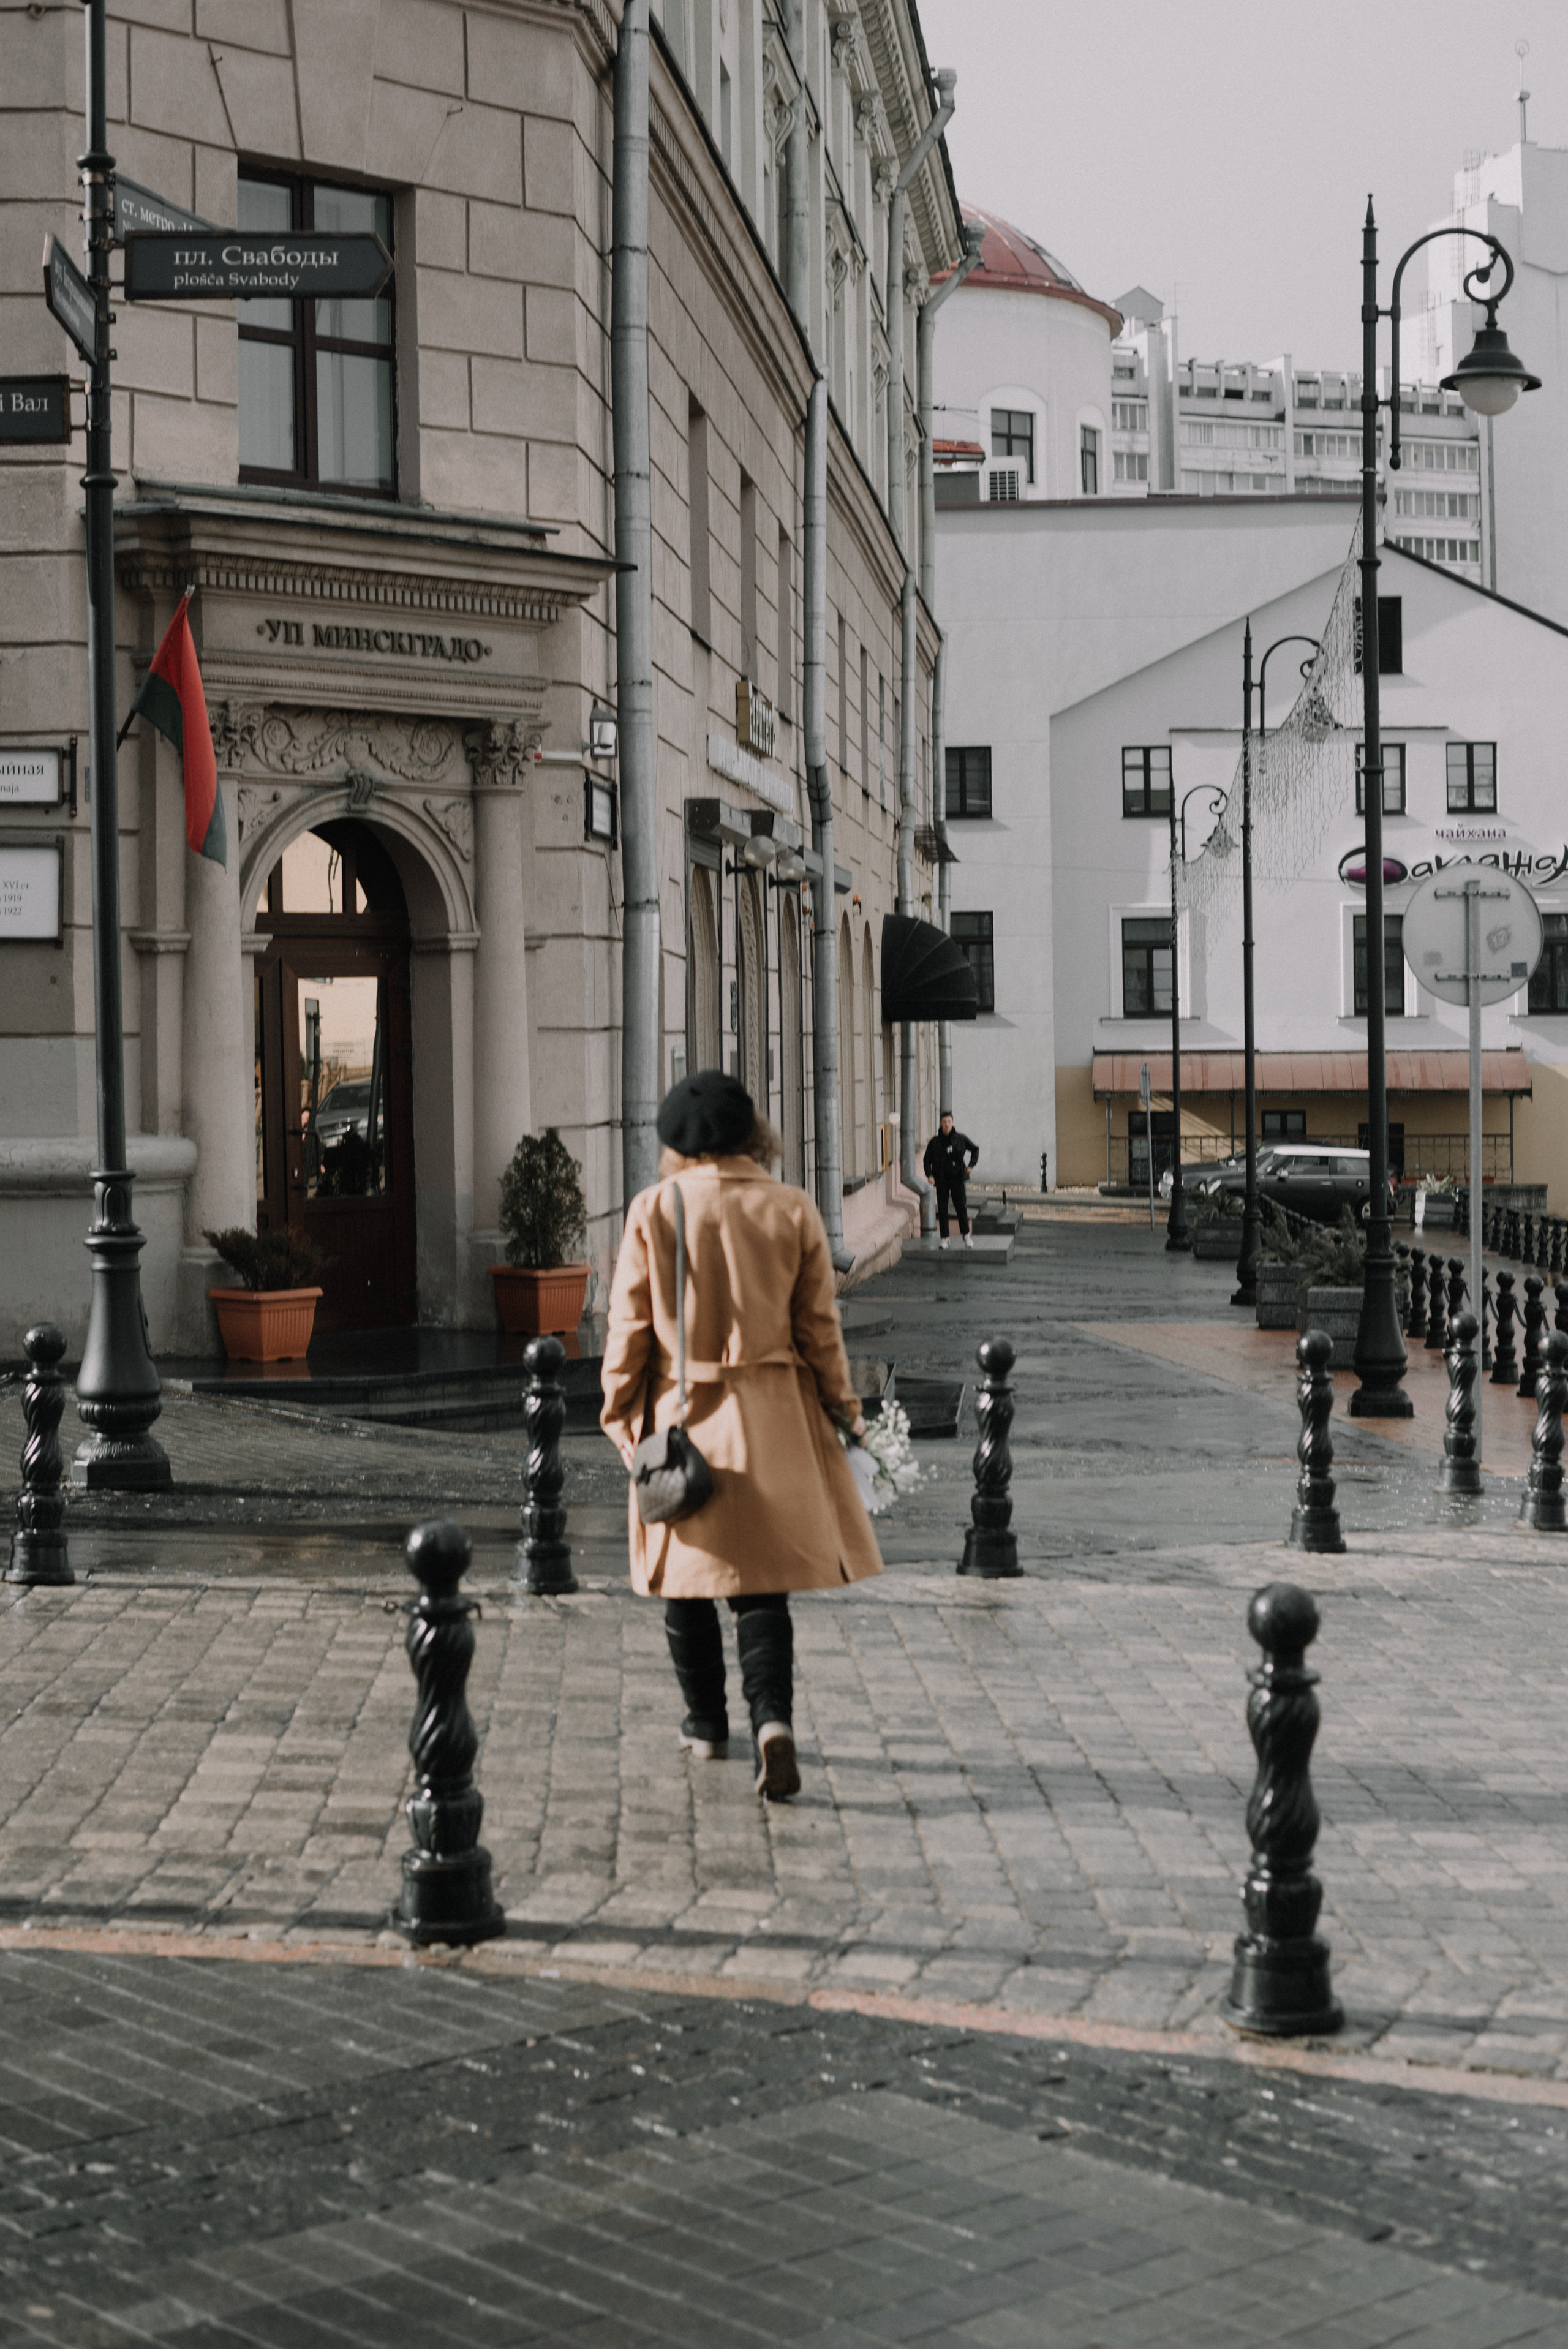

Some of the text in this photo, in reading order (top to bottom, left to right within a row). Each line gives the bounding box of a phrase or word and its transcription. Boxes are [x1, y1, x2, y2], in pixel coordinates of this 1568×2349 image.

[174, 246, 339, 268] пл. Свабоды
[174, 272, 299, 290] plošča Svabody
[11, 392, 48, 412] Вал
[265, 619, 484, 663] УП МИНСКГРАДО
[1434, 823, 1507, 839] чайхана
